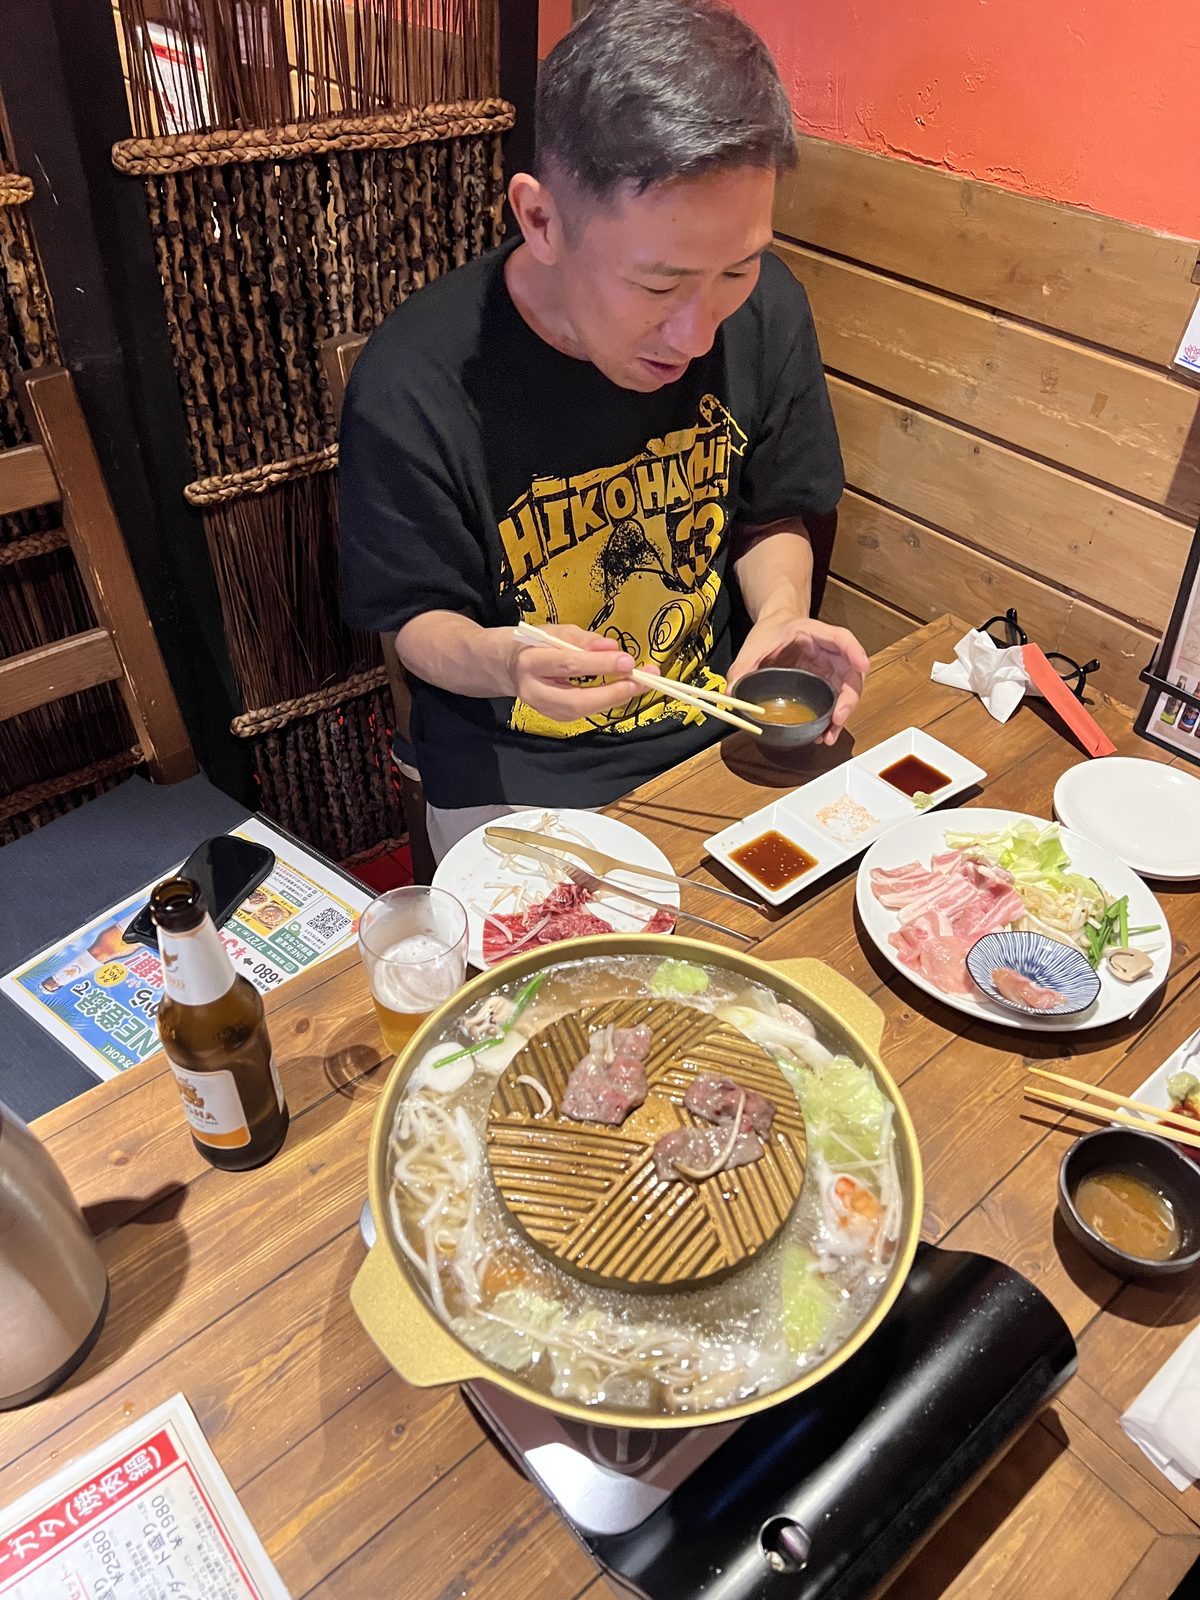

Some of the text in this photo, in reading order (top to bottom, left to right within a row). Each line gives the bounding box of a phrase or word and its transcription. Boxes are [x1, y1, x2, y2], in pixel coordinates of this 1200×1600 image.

[103, 968, 118, 980] No.1
[251, 962, 283, 984] ¥680
[150, 1494, 183, 1550] ¥1980
[92, 1529, 126, 1586] ¥2980
